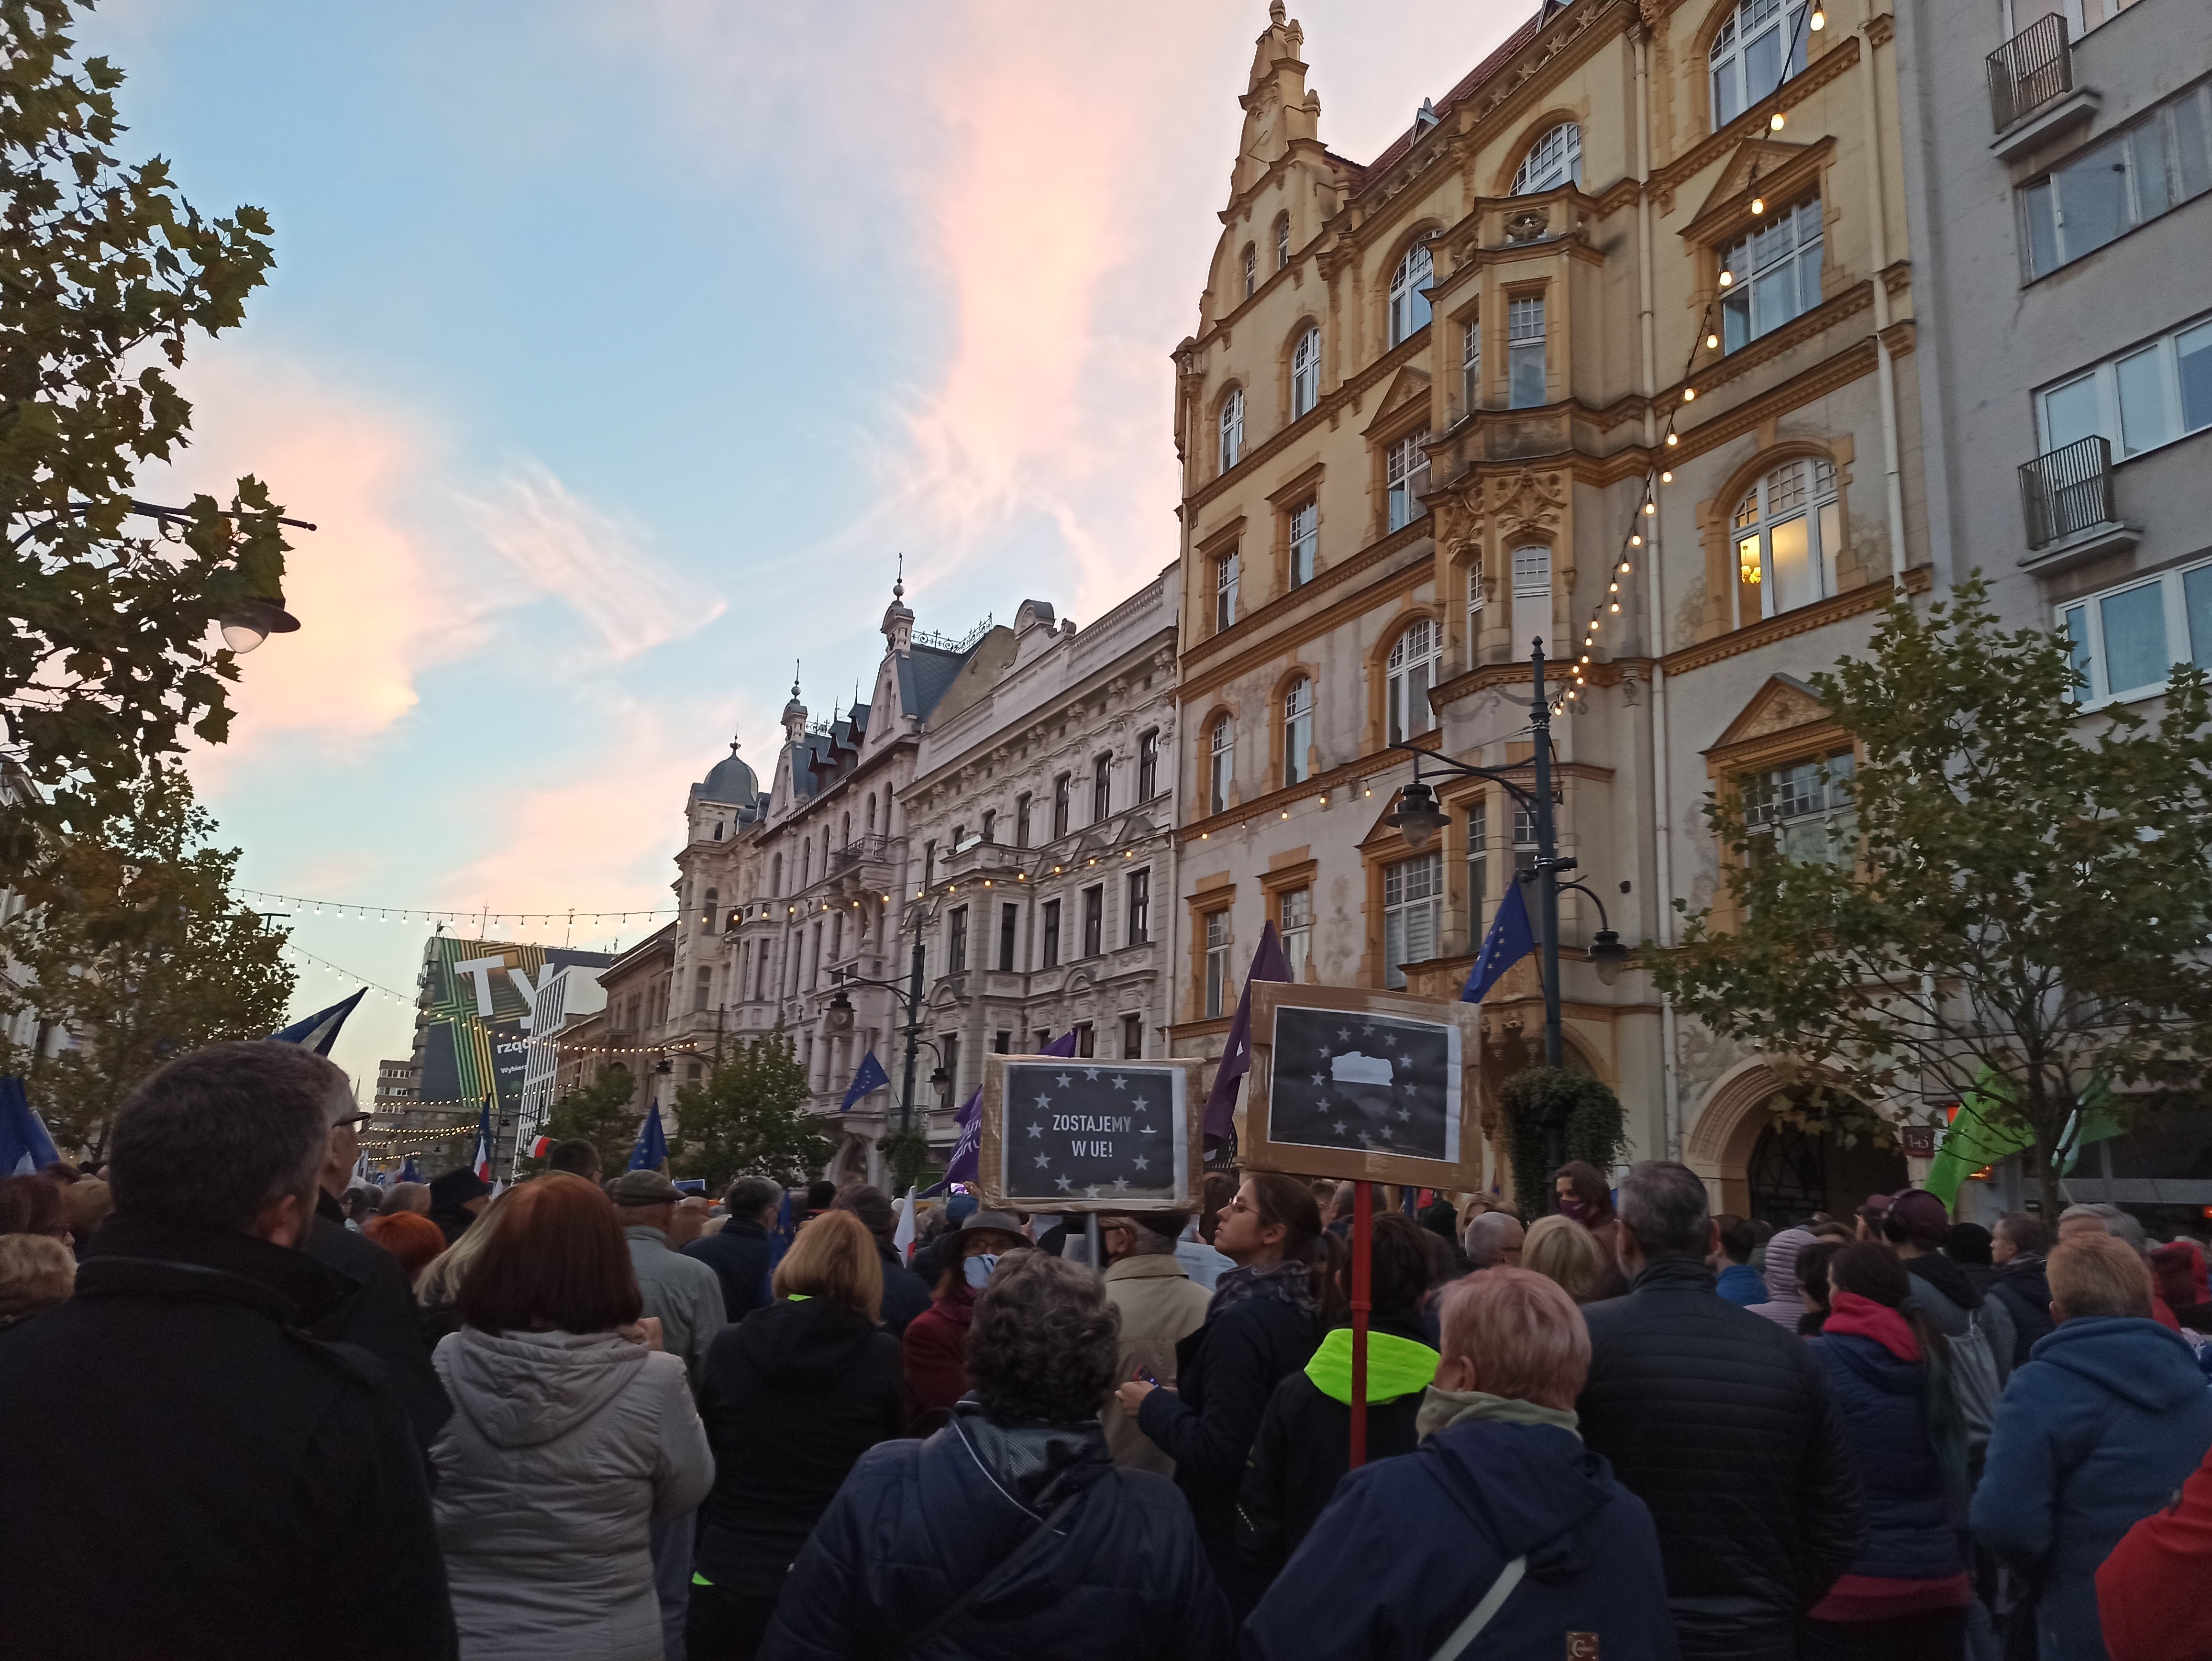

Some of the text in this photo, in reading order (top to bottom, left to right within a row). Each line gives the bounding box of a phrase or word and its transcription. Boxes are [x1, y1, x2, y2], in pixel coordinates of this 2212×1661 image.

[454, 955, 554, 1029] Ty
[1053, 1114, 1131, 1132] ZOSTAJEMY
[1072, 1141, 1113, 1157] W UE!
